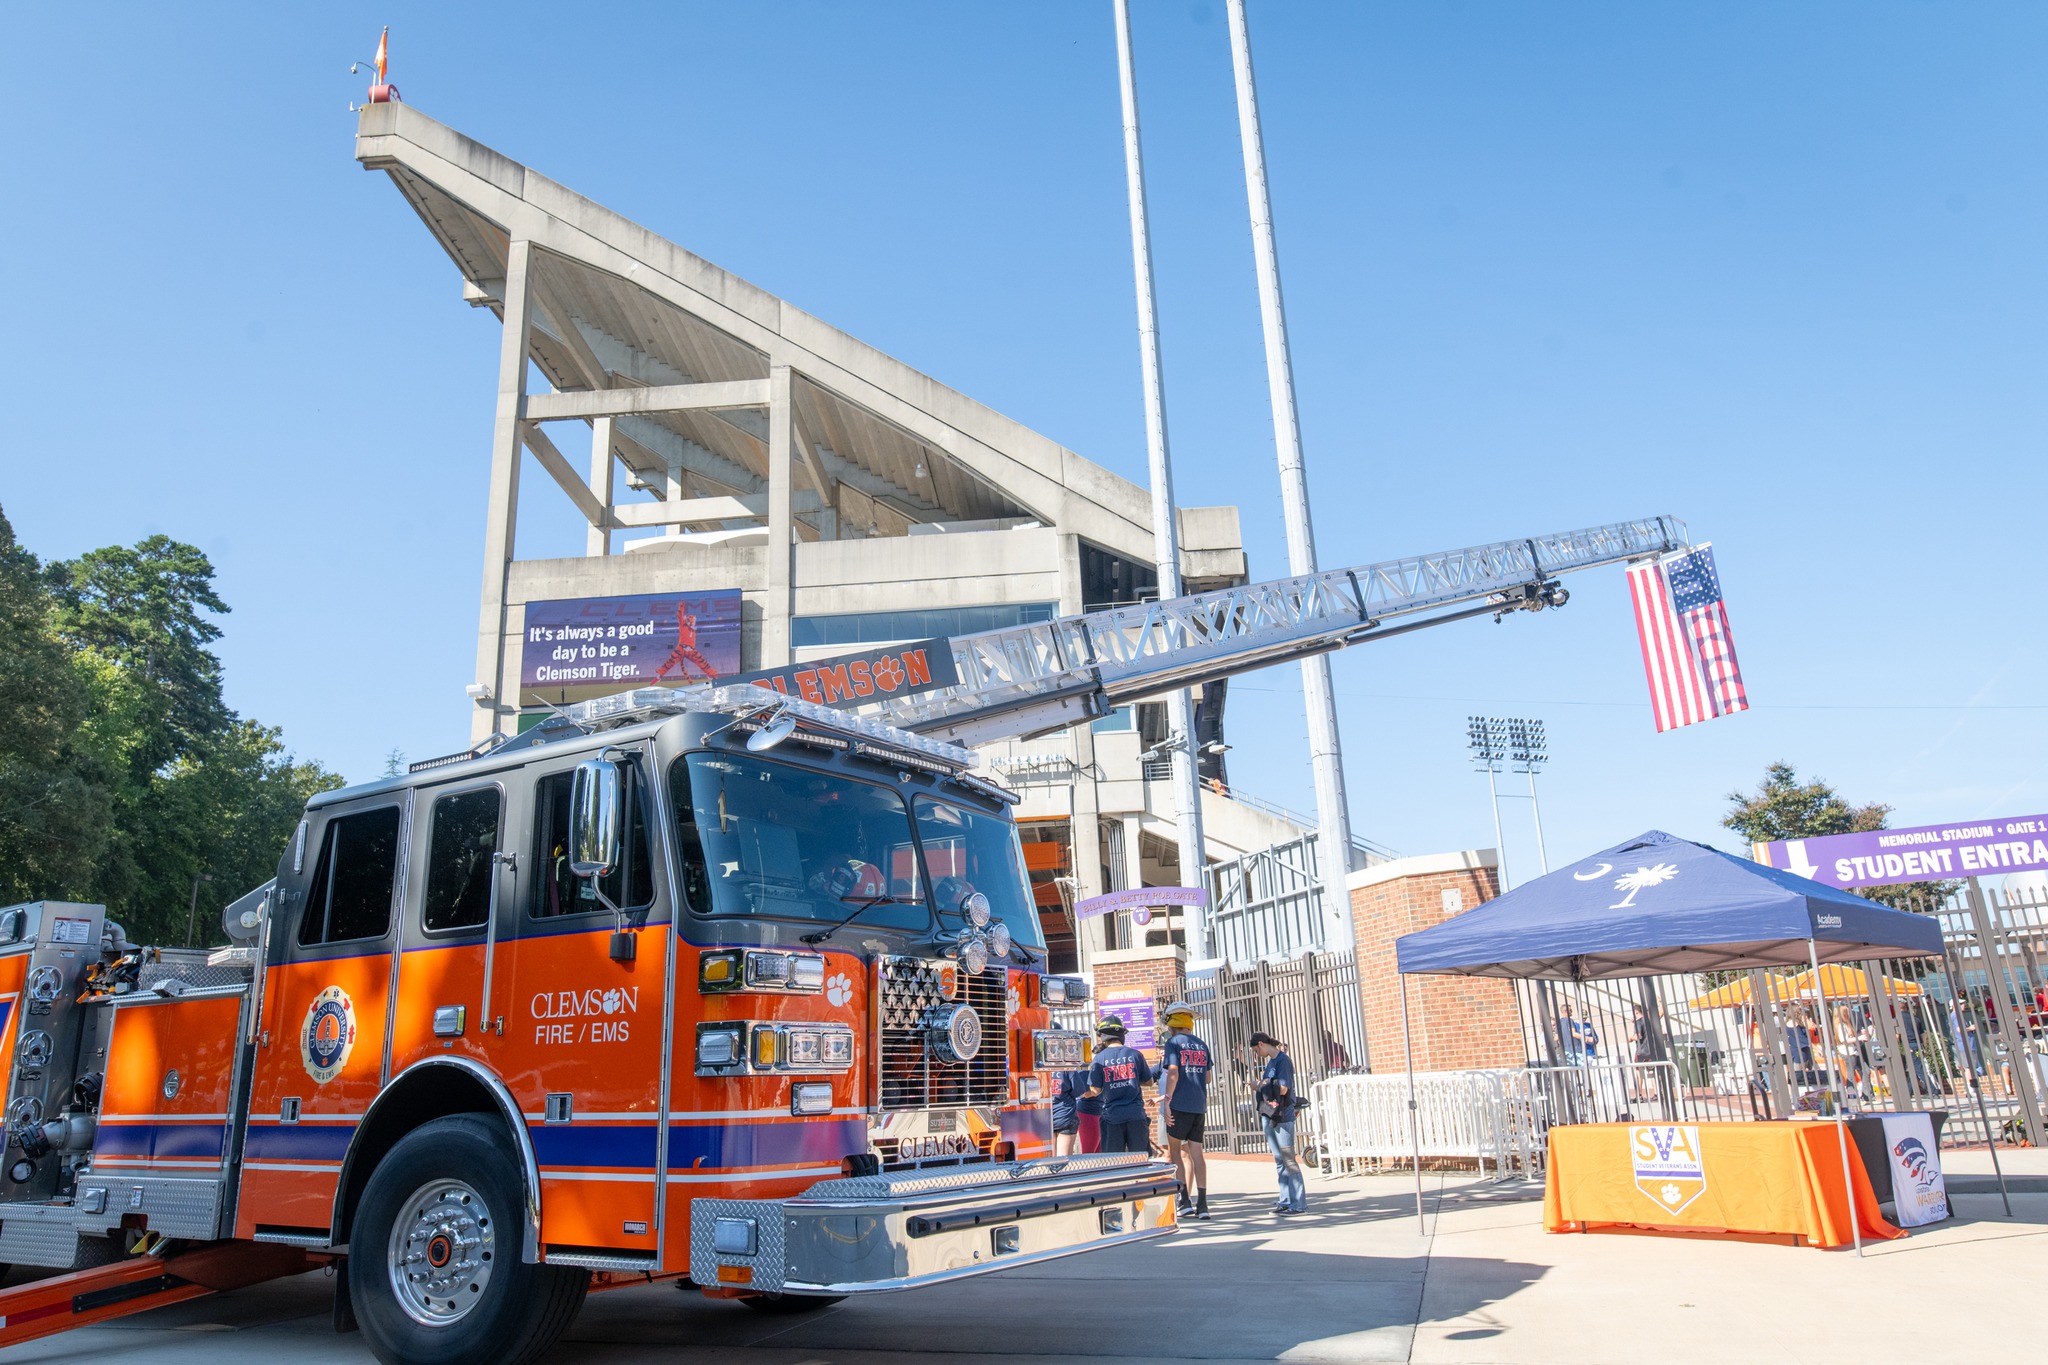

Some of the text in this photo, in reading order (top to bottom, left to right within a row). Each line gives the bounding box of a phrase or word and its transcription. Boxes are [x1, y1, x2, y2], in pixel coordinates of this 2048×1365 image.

[530, 620, 654, 642] It's always a good
[552, 643, 629, 662] day to be a
[536, 662, 640, 681] Clemson Tiger.
[1879, 820, 2048, 848] MEMORIAL STADIUM GATE 1
[1835, 839, 2048, 882] STUDENT ENTRA
[1083, 900, 1106, 913] BILLY
[1120, 893, 1149, 903] BETTY
[1152, 891, 1171, 900] POE
[1173, 892, 1198, 900] GATE
[1138, 913, 1143, 922] 1
[1817, 914, 1842, 927] Academy
[310, 1003, 347, 1049] CLEMSON UNIVERSITY
[535, 1024, 574, 1045] FIRE
[591, 1021, 629, 1043] EMS
[1104, 1056, 1133, 1066] PCCTC
[1181, 1050, 1207, 1066] FIRE
[313, 1069, 322, 1080] FIRE
[1103, 1063, 1136, 1083] FIRE
[1635, 1127, 1697, 1162] SVA
